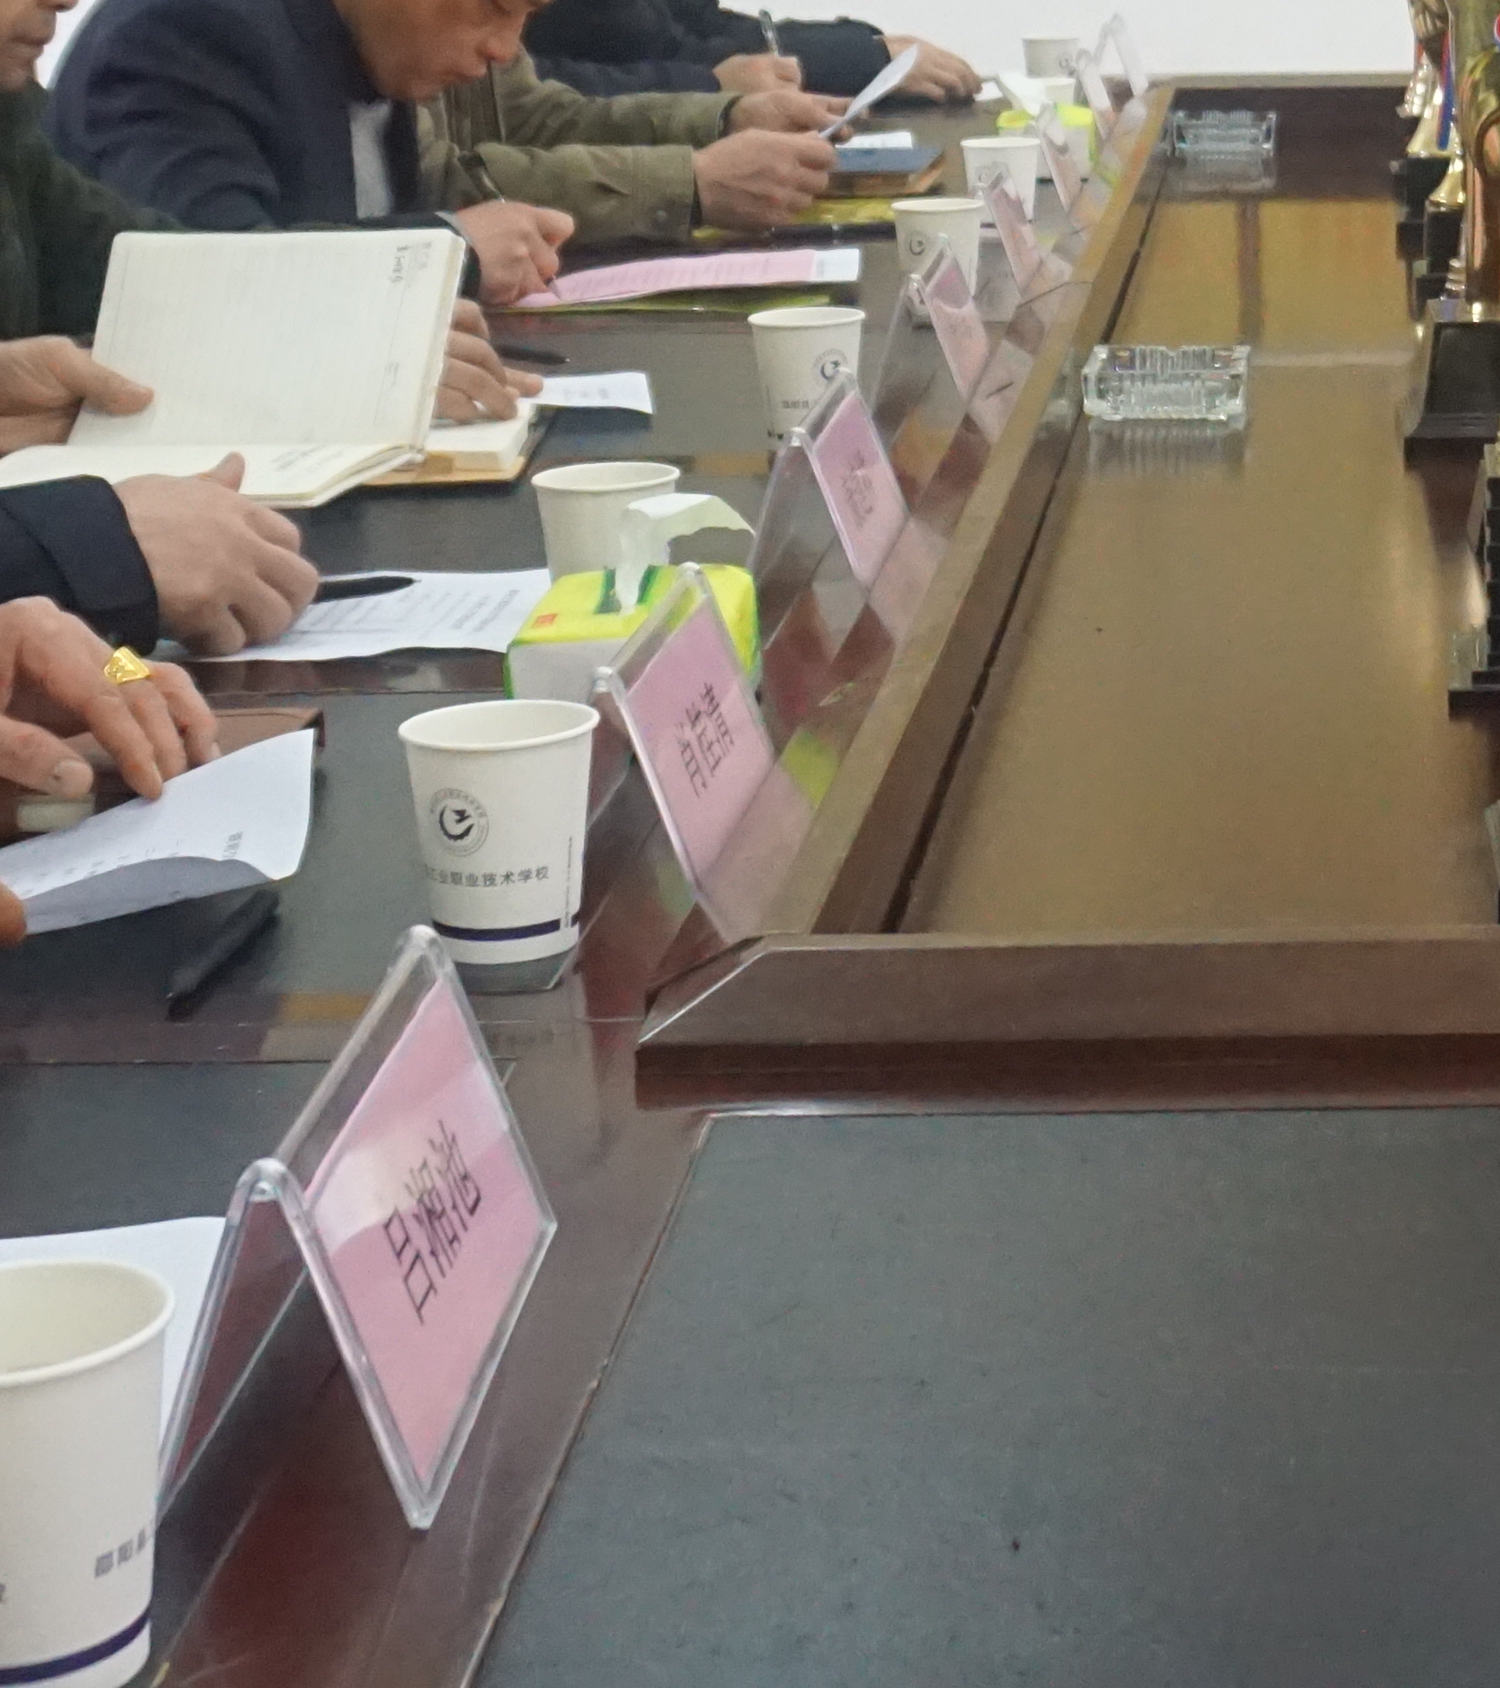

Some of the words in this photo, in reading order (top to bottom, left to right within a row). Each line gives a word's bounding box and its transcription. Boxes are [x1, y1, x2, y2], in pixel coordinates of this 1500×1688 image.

[383, 1120, 481, 1325] 吕湘池
[94, 1513, 156, 1579] 邵阳县
